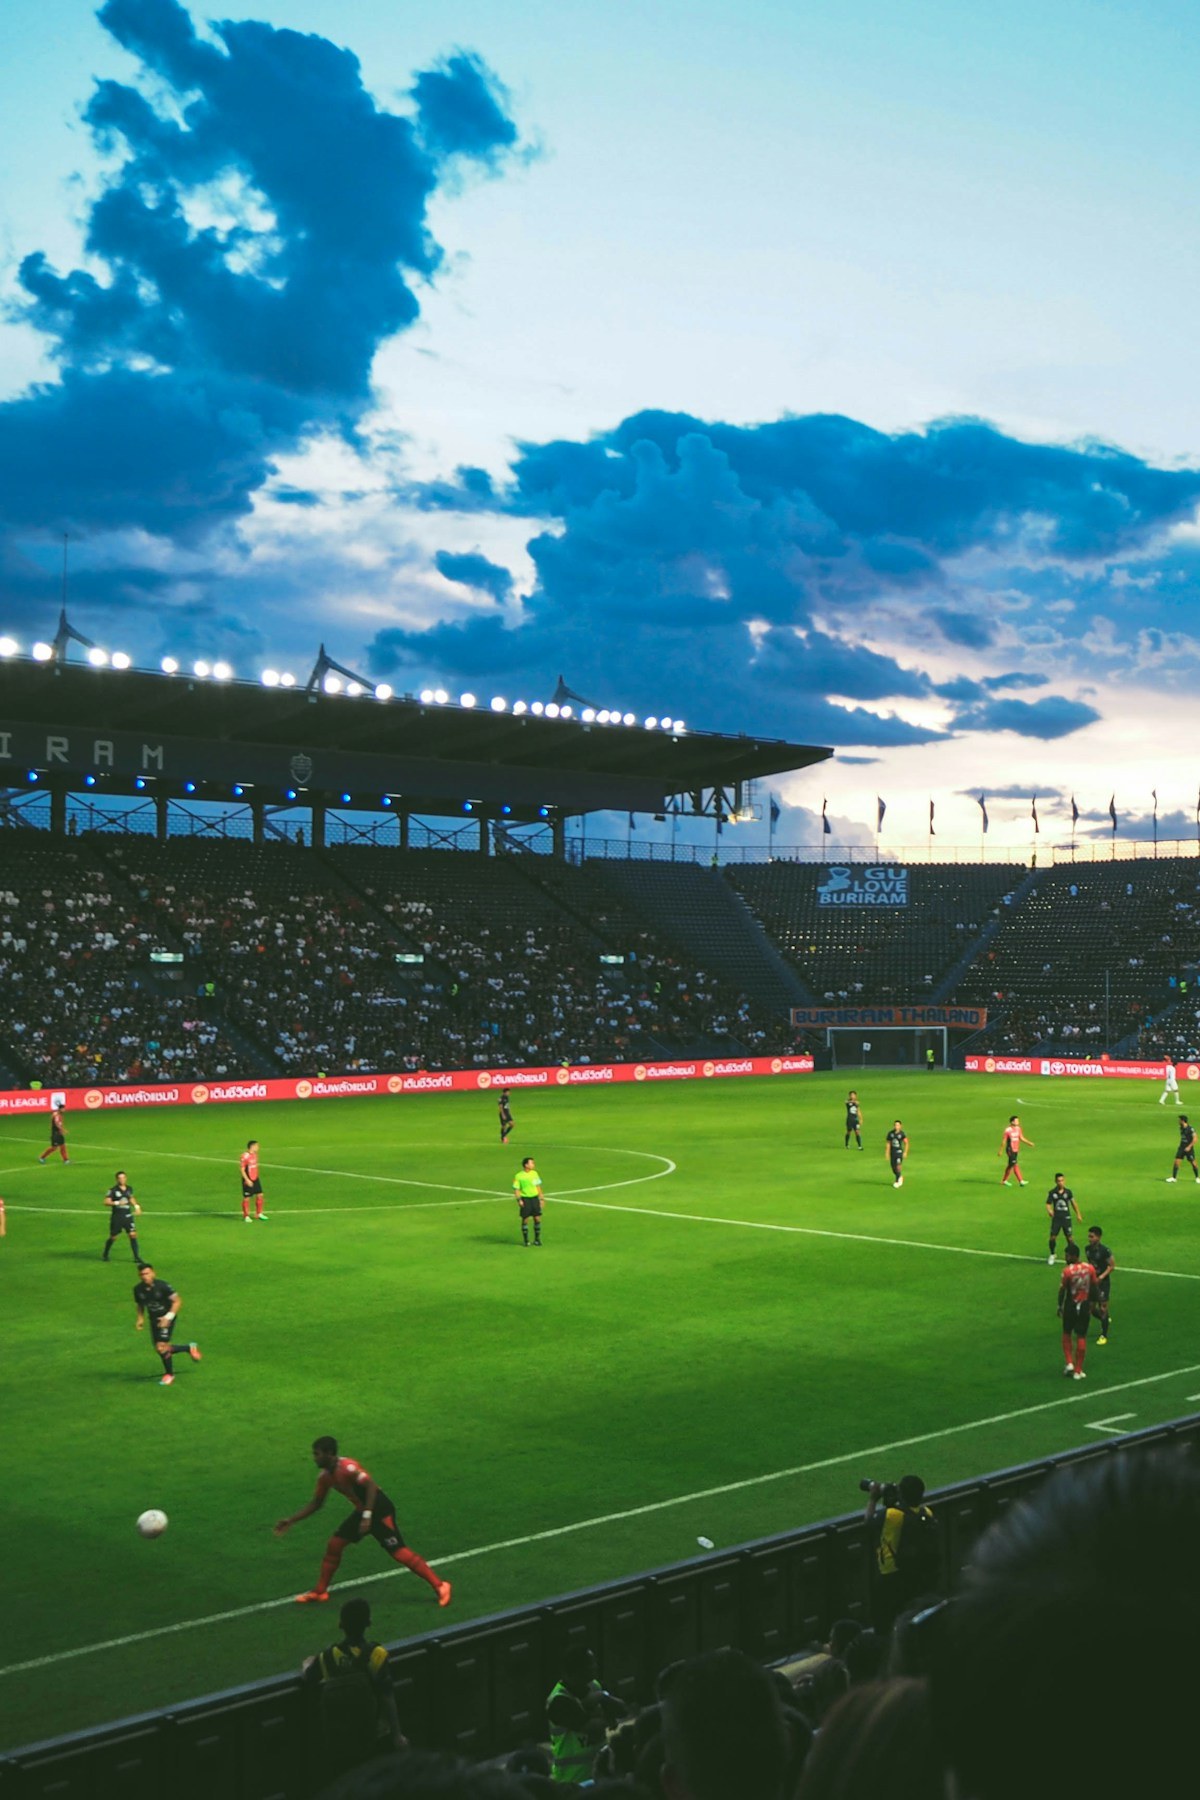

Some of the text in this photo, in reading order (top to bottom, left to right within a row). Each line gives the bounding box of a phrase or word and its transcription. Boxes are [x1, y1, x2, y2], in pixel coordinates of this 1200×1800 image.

[864, 867, 907, 880] GU
[853, 880, 907, 892] LOVE
[819, 892, 907, 904] BURIRAM
[795, 1008, 979, 1025] BURIRAM THAILAND
[1065, 1063, 1103, 1075] TOYOTA
[1117, 1066, 1142, 1074] PREMIER
[1142, 1068, 1164, 1076] LEAGUE
[10, 1097, 48, 1108] LEAGUE
